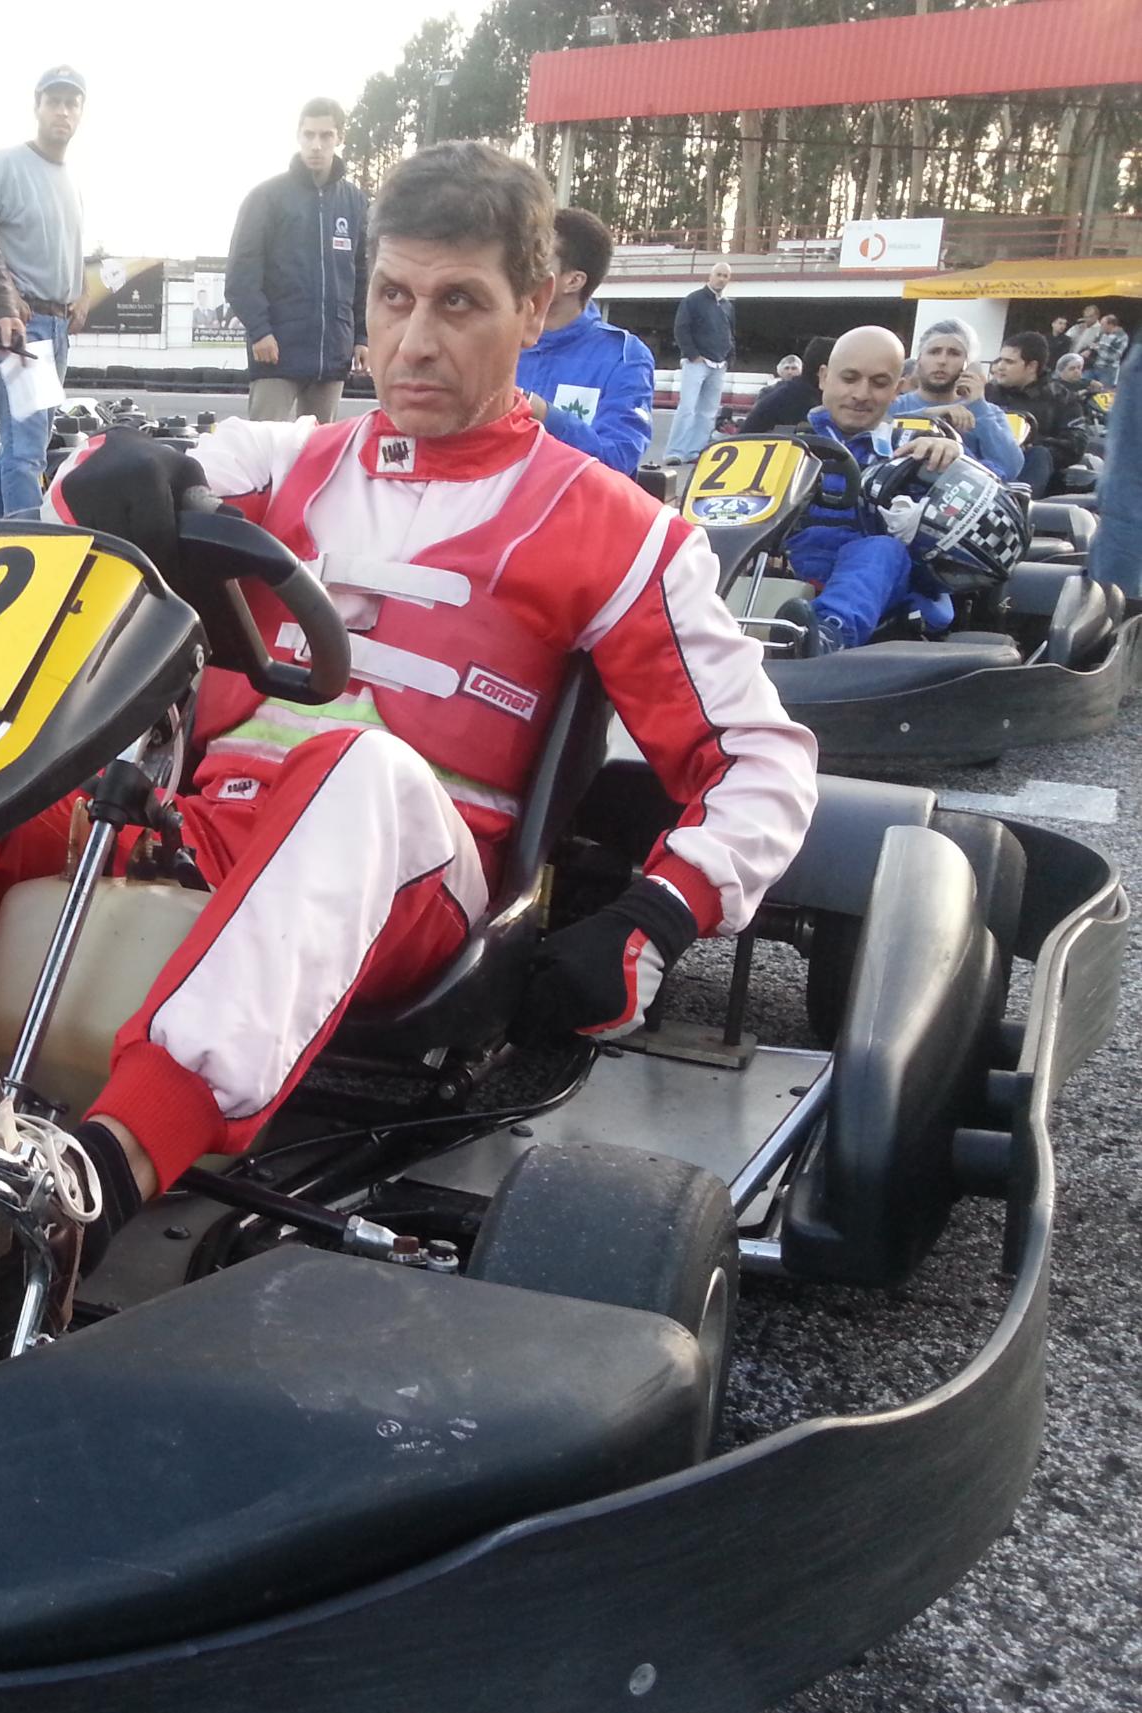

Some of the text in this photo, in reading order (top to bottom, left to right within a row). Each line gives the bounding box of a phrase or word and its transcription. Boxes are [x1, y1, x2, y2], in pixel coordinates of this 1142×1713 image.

[698, 443, 778, 493] 21
[708, 499, 740, 514] 24
[470, 673, 535, 713] Comer
